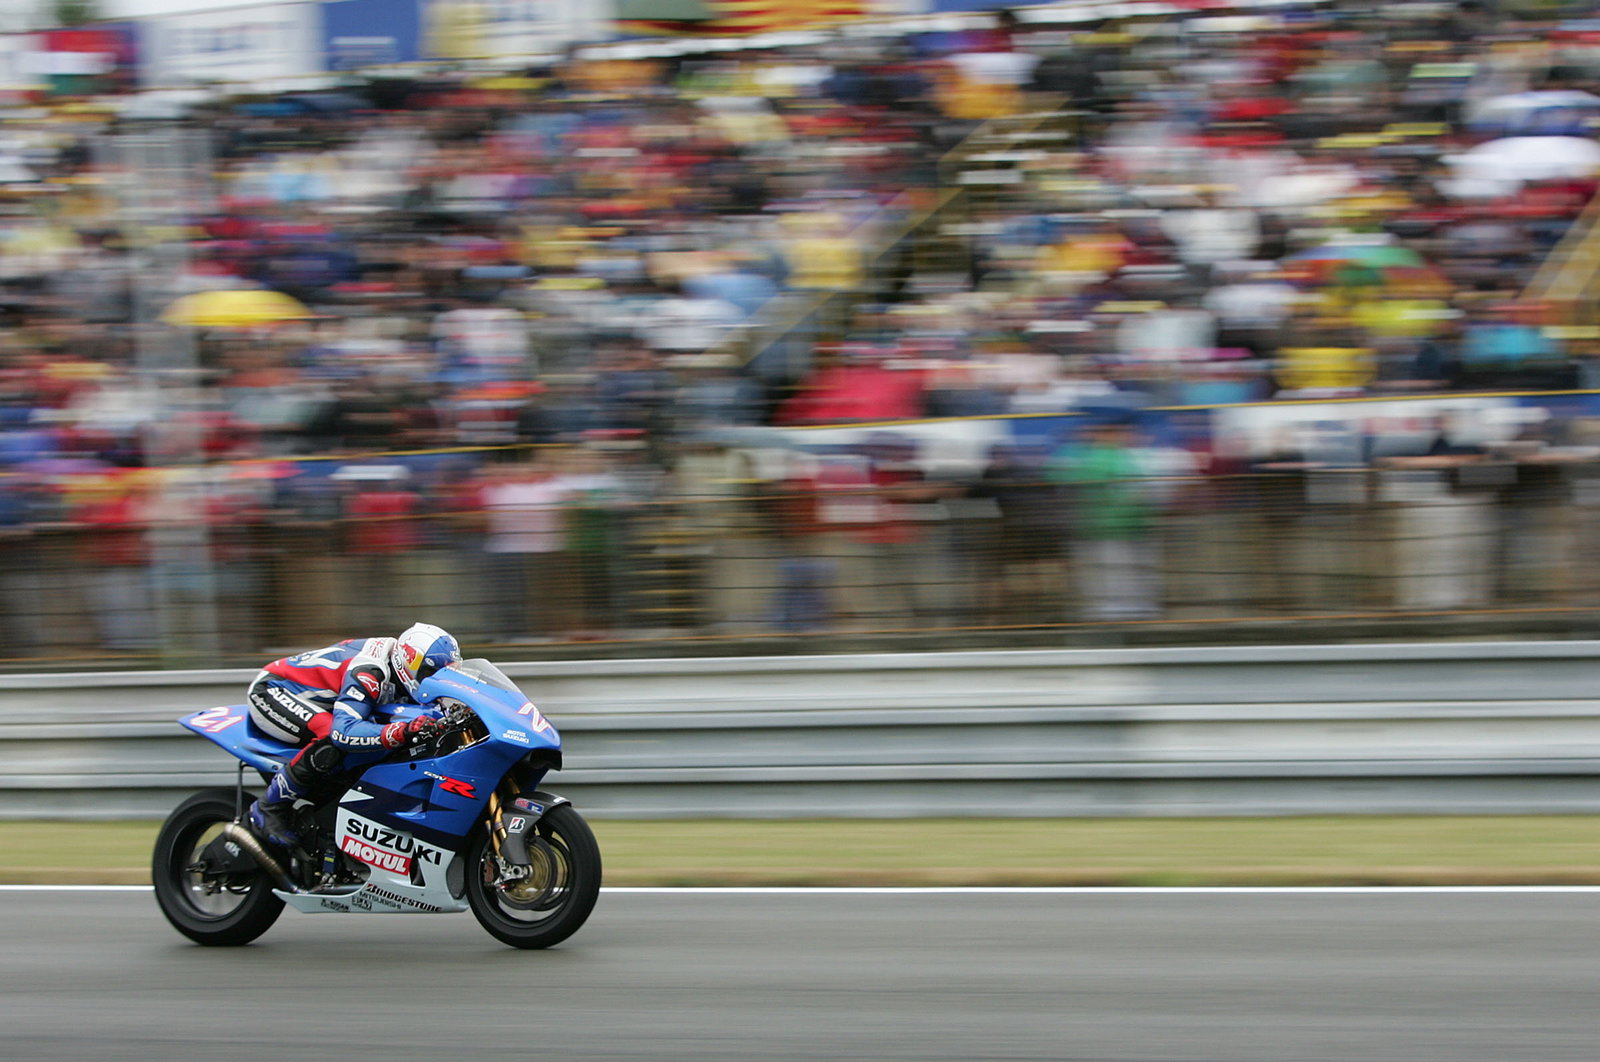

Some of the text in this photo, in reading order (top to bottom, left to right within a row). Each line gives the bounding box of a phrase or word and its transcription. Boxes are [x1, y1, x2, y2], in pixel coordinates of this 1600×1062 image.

[189, 706, 246, 733] 21
[267, 687, 313, 721] SUZUKI
[331, 730, 382, 746] SUZUK
[343, 839, 407, 873] MOTUL
[346, 818, 442, 866] SUZUKI
[364, 883, 443, 912] BRIDGESTONE
